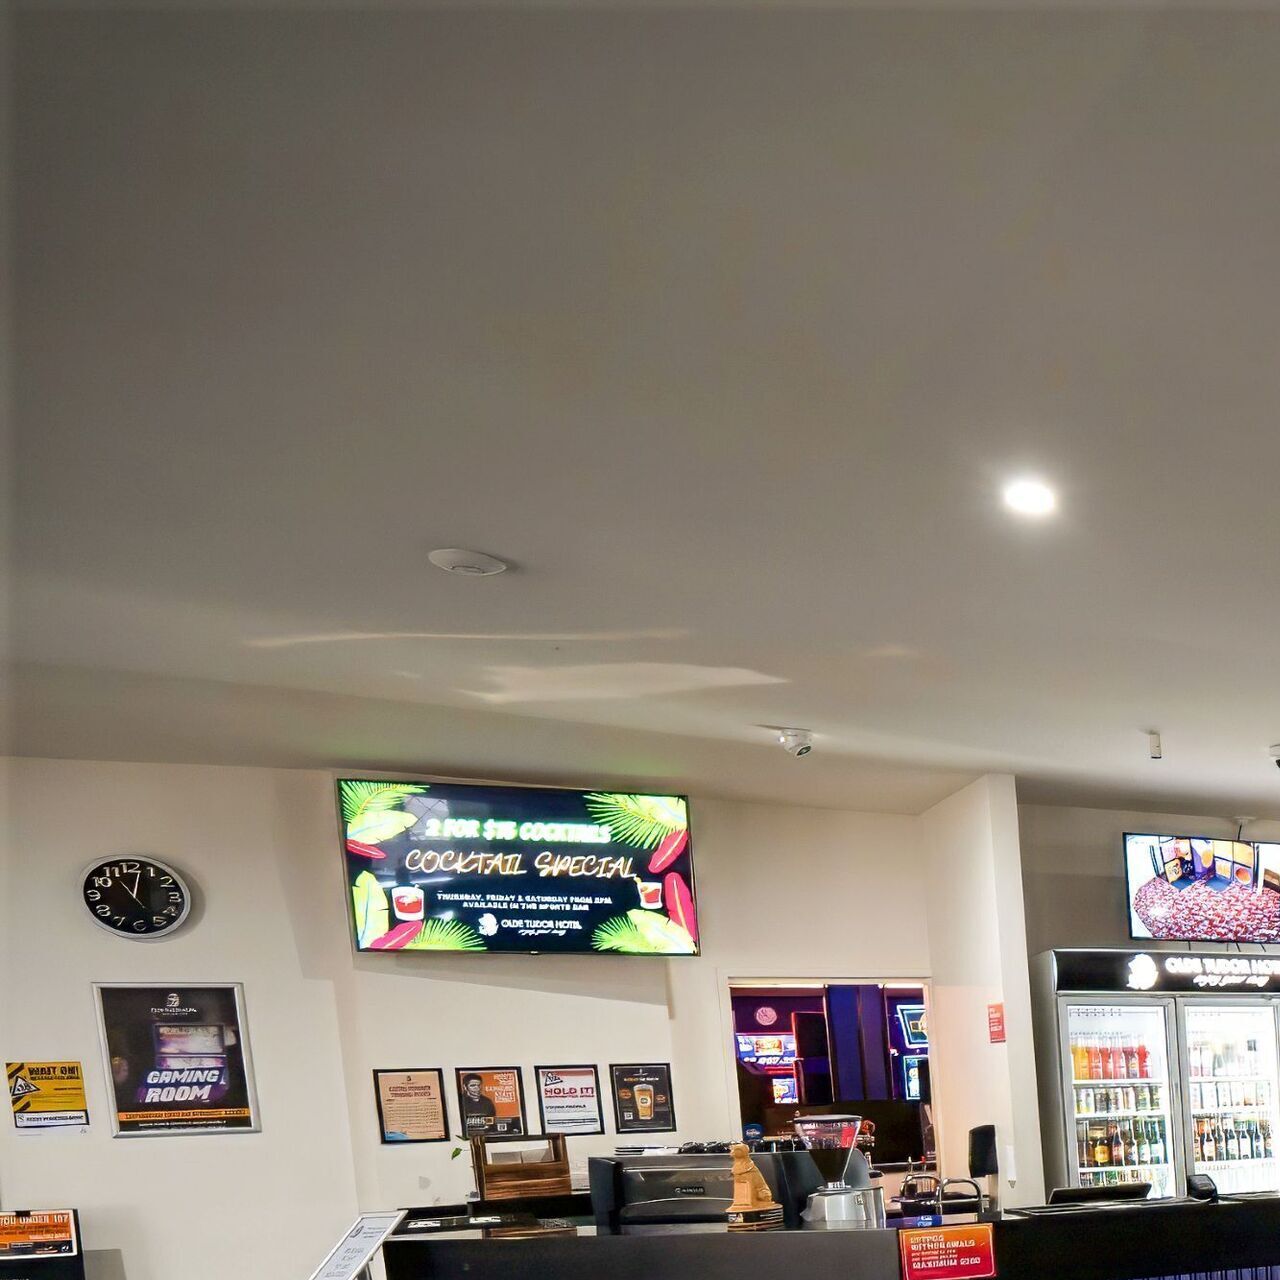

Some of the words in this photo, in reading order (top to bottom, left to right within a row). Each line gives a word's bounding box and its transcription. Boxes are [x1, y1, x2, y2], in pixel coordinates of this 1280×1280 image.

[119, 862, 141, 873] 12
[405, 849, 527, 875] COCKTAIL
[534, 851, 639, 879] SPECIAL
[146, 867, 155, 877] 1
[92, 876, 112, 887] 10
[160, 876, 175, 888] 2
[147, 1070, 219, 1083] GAMING
[145, 1085, 211, 1103] ROOM
[545, 1088, 576, 1096] HOLD
